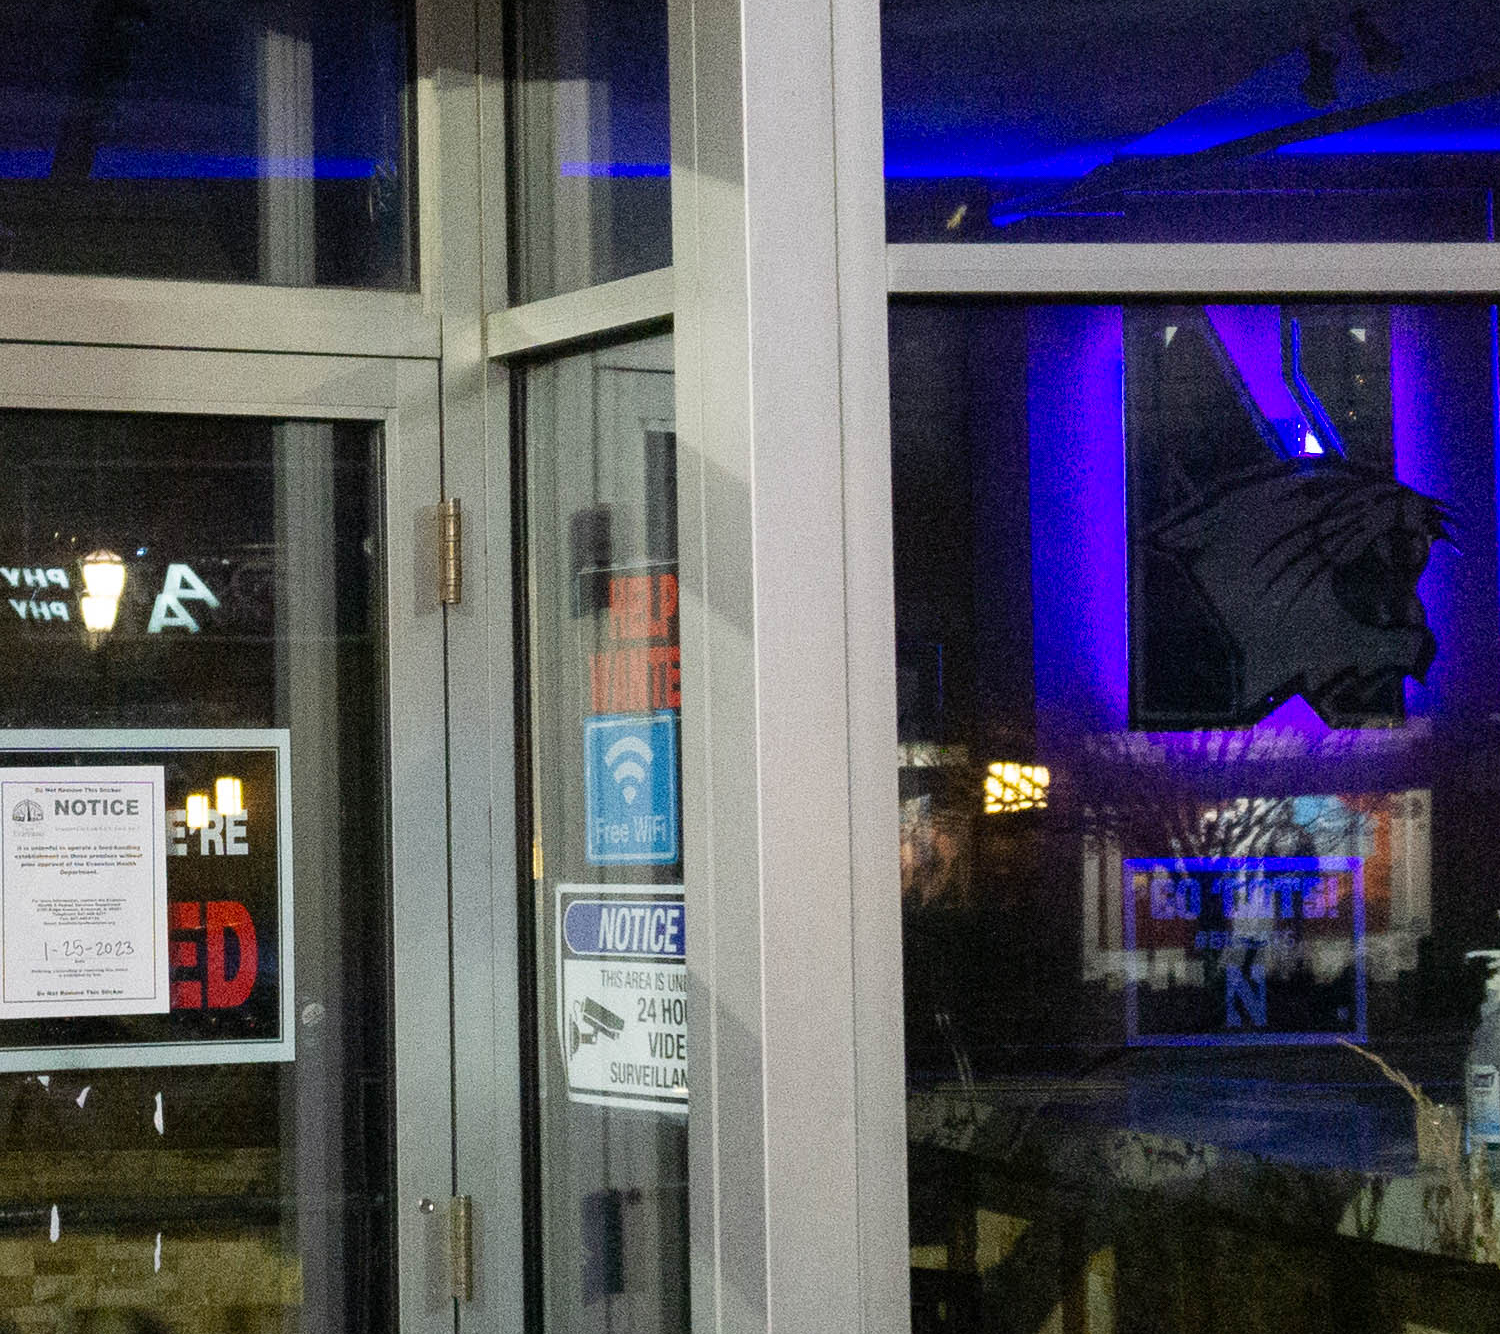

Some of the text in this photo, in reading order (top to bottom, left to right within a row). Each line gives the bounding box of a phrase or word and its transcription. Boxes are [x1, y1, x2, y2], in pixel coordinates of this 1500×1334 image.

[589, 647, 682, 713] WANTE
[54, 799, 140, 816] NOTICE
[595, 817, 630, 844] Free
[598, 907, 679, 953] NOTICE
[600, 970, 623, 989] THIS
[625, 971, 652, 990] AREA
[654, 972, 665, 992] IS
[636, 998, 660, 1023] 24
